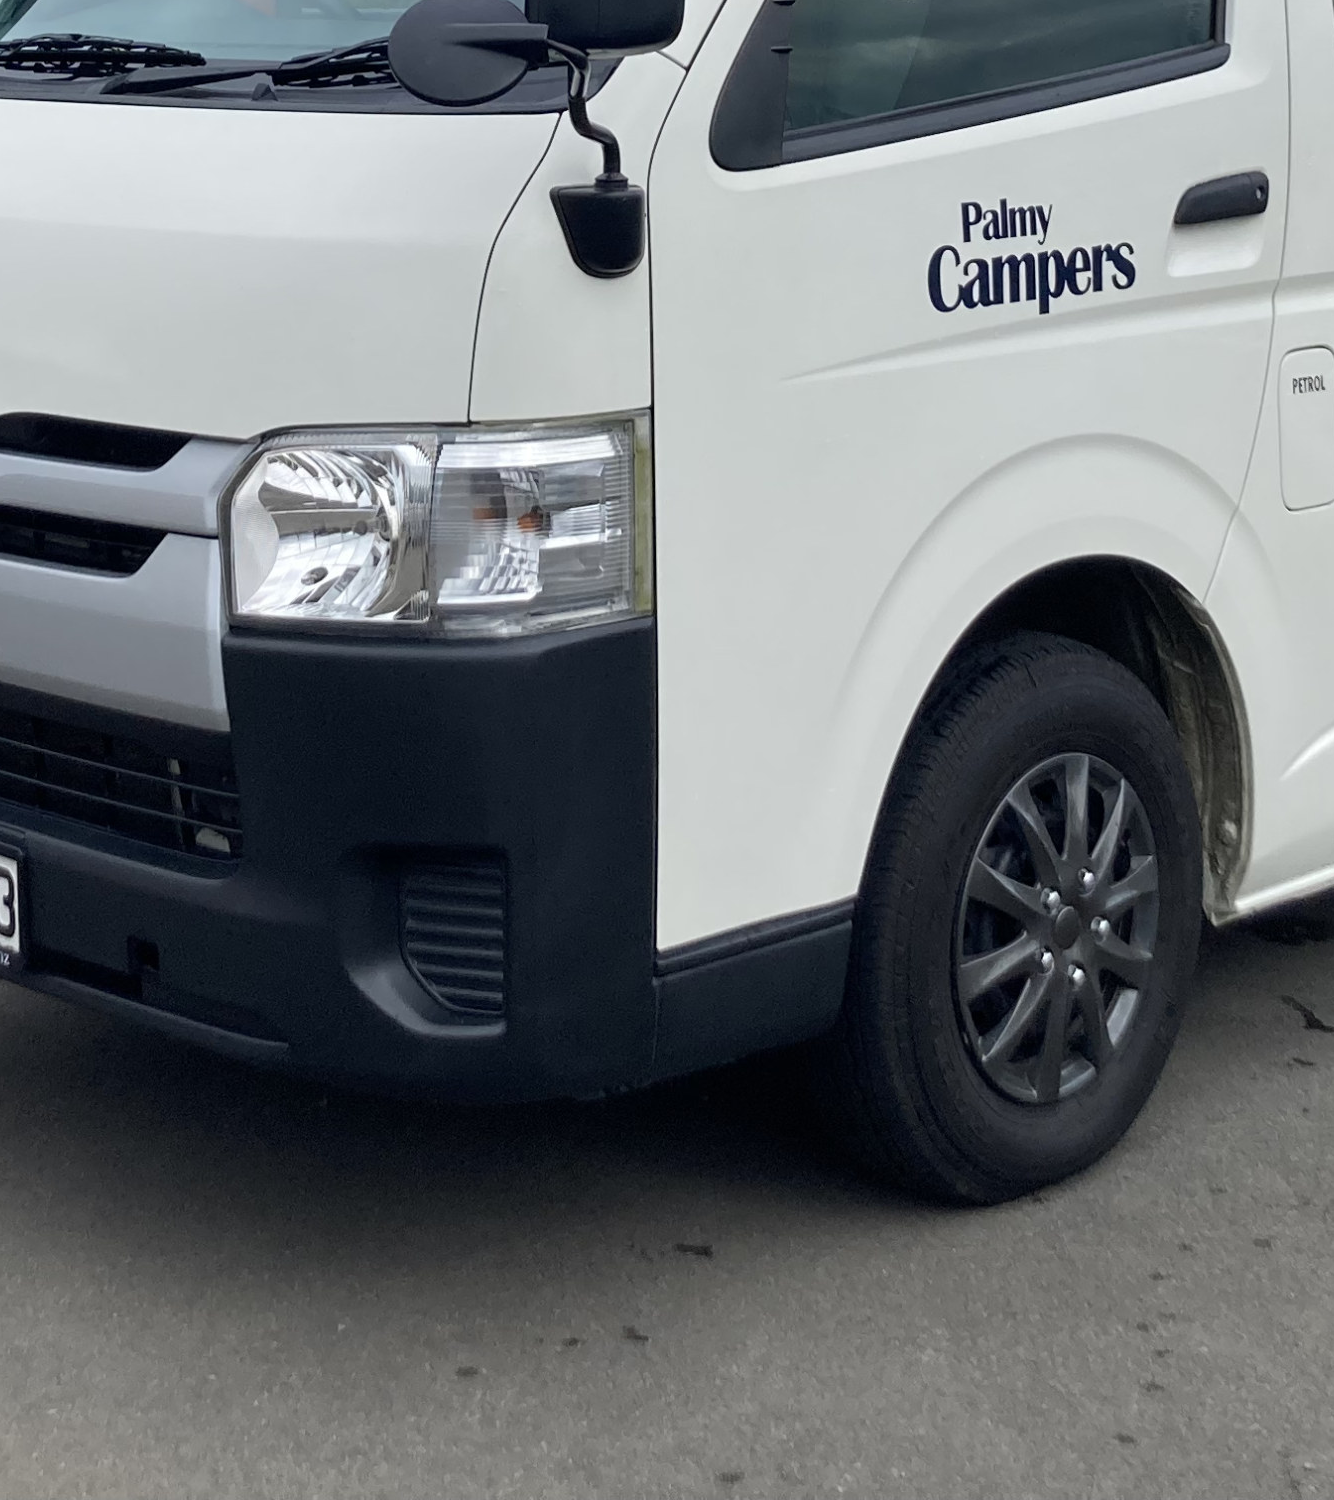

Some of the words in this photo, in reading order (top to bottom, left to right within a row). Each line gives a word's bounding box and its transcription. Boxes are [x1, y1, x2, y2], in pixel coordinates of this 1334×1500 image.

[961, 198, 1053, 246] Palmy
[927, 242, 1136, 315] Campers
[1292, 375, 1326, 394] PETROL
